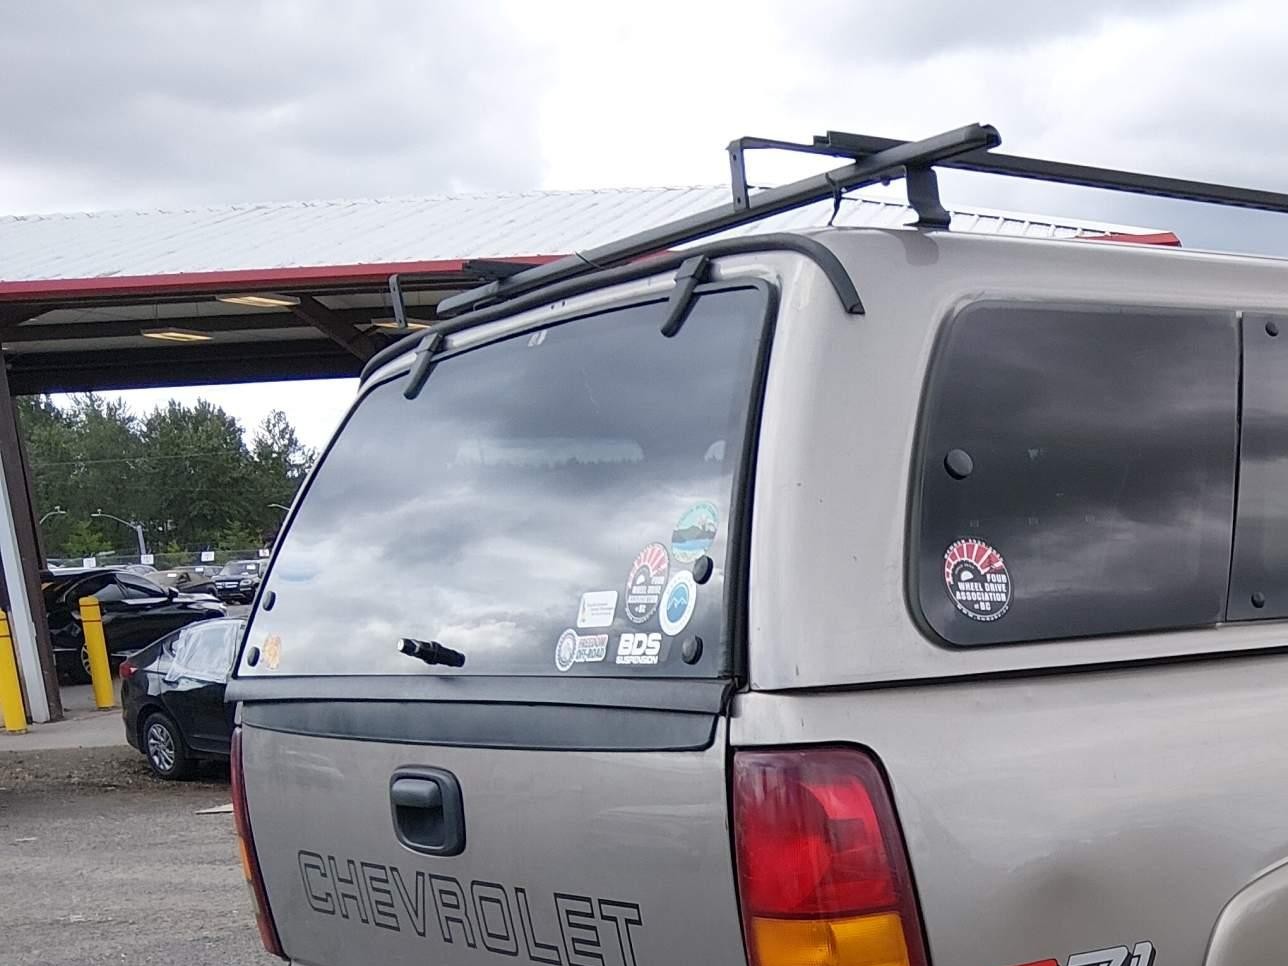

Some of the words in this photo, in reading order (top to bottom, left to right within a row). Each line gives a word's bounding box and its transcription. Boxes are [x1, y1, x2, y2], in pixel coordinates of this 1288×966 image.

[986, 573, 1007, 583] FOUR
[957, 582, 983, 592] WHEEL
[984, 583, 1007, 593] DRIVE
[955, 591, 1007, 602] ASSOCIATION
[617, 632, 662, 656] BDS
[615, 655, 659, 665] SUSPENSION
